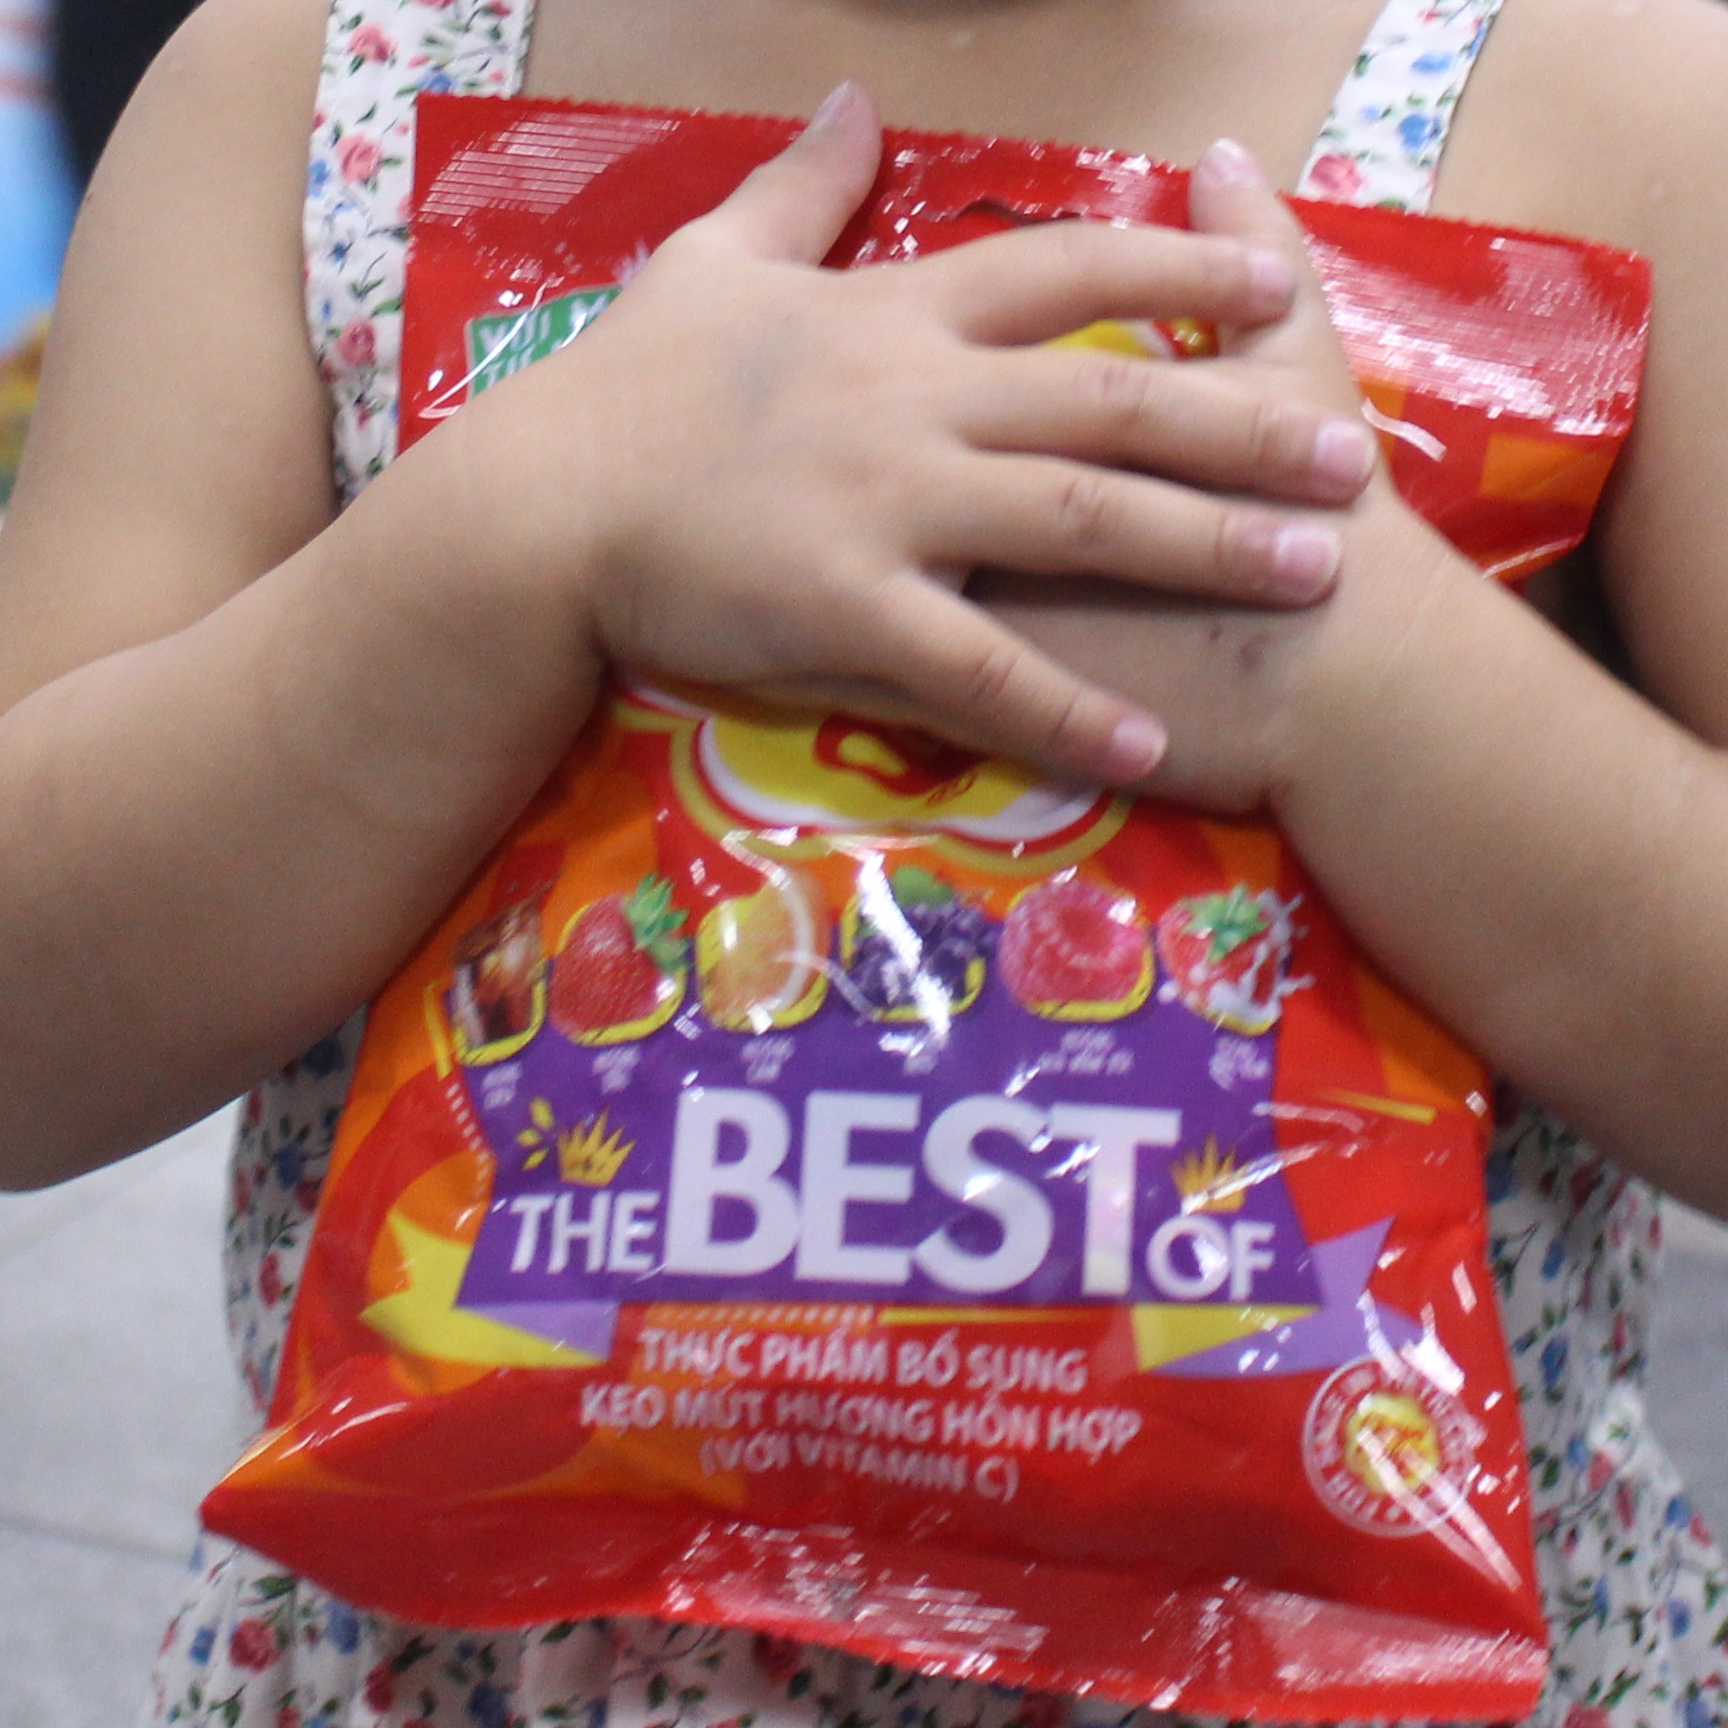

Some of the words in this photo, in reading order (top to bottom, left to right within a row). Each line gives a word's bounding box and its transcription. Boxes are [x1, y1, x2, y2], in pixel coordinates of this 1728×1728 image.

[508, 1189, 663, 1275] THE
[663, 1085, 1183, 1297] BEST
[1145, 1213, 1276, 1302] OF
